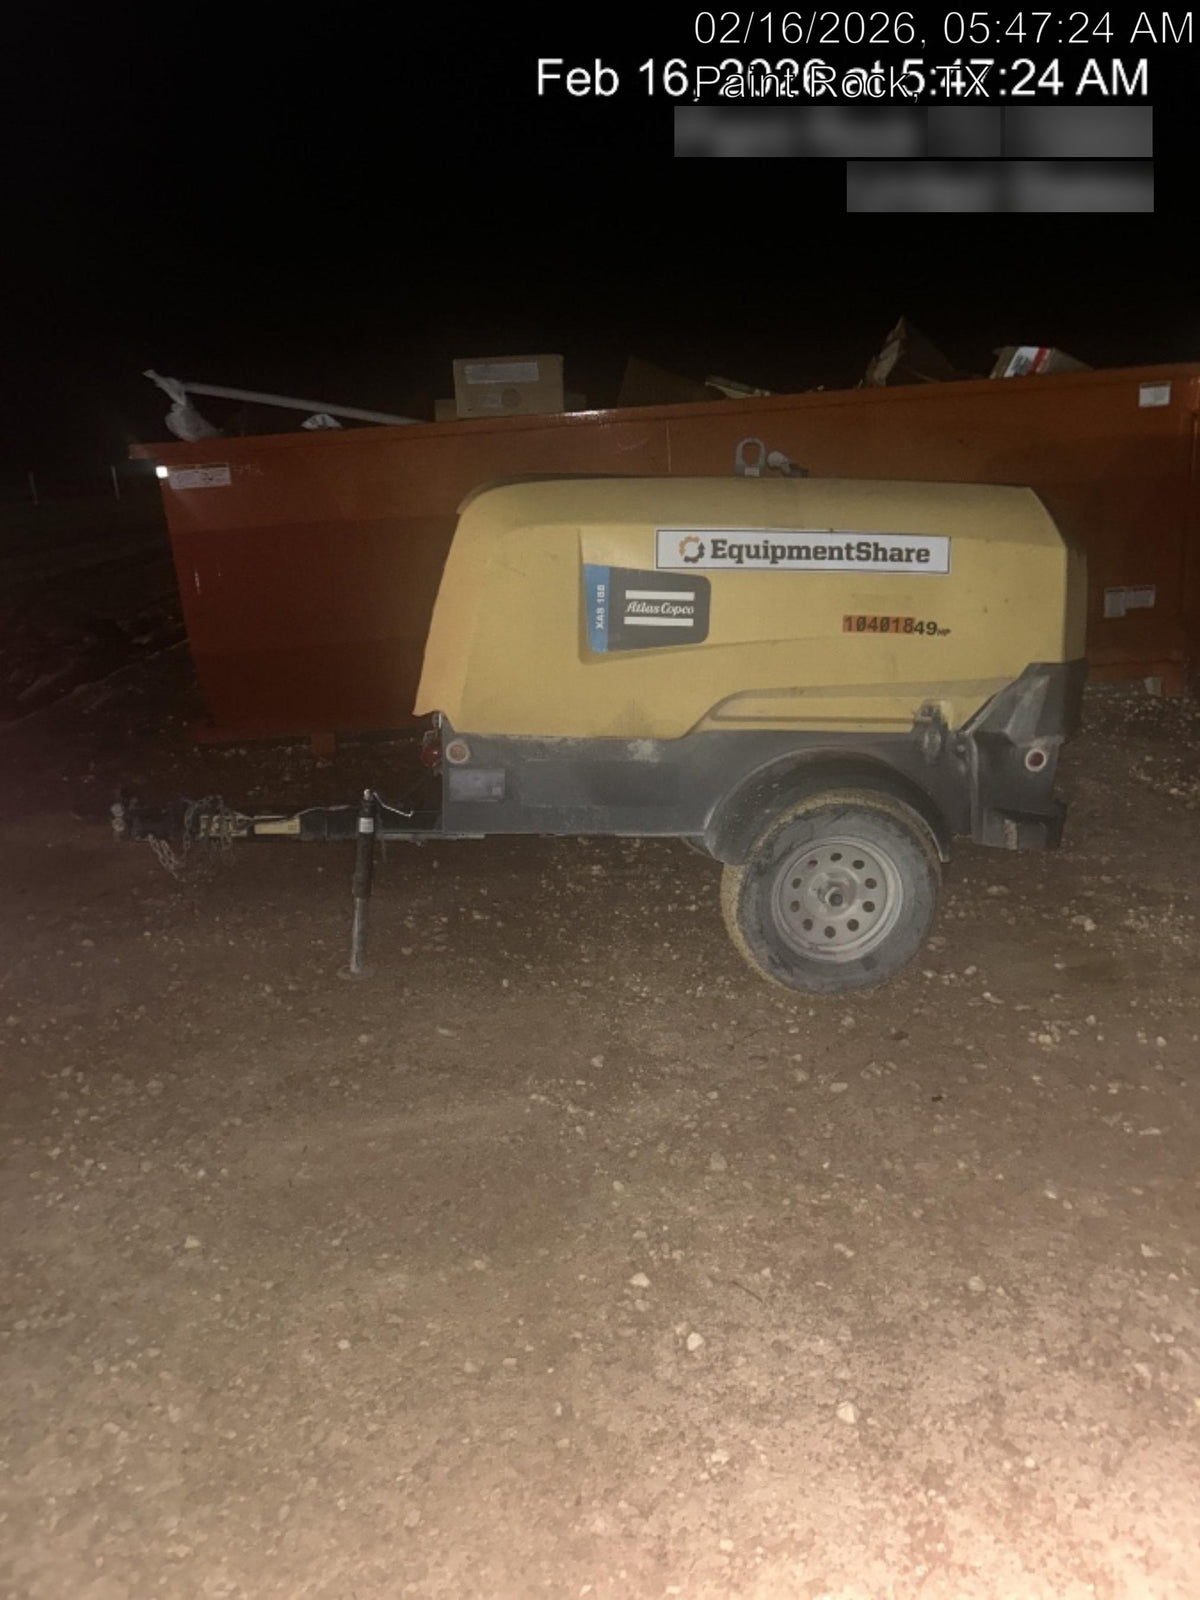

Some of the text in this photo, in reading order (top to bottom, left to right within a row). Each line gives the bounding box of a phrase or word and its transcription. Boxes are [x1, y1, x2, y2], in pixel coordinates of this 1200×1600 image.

[710, 538, 931, 564] EquipmentShare
[594, 607, 606, 630] XAS
[625, 601, 695, 617] Atlas Copco
